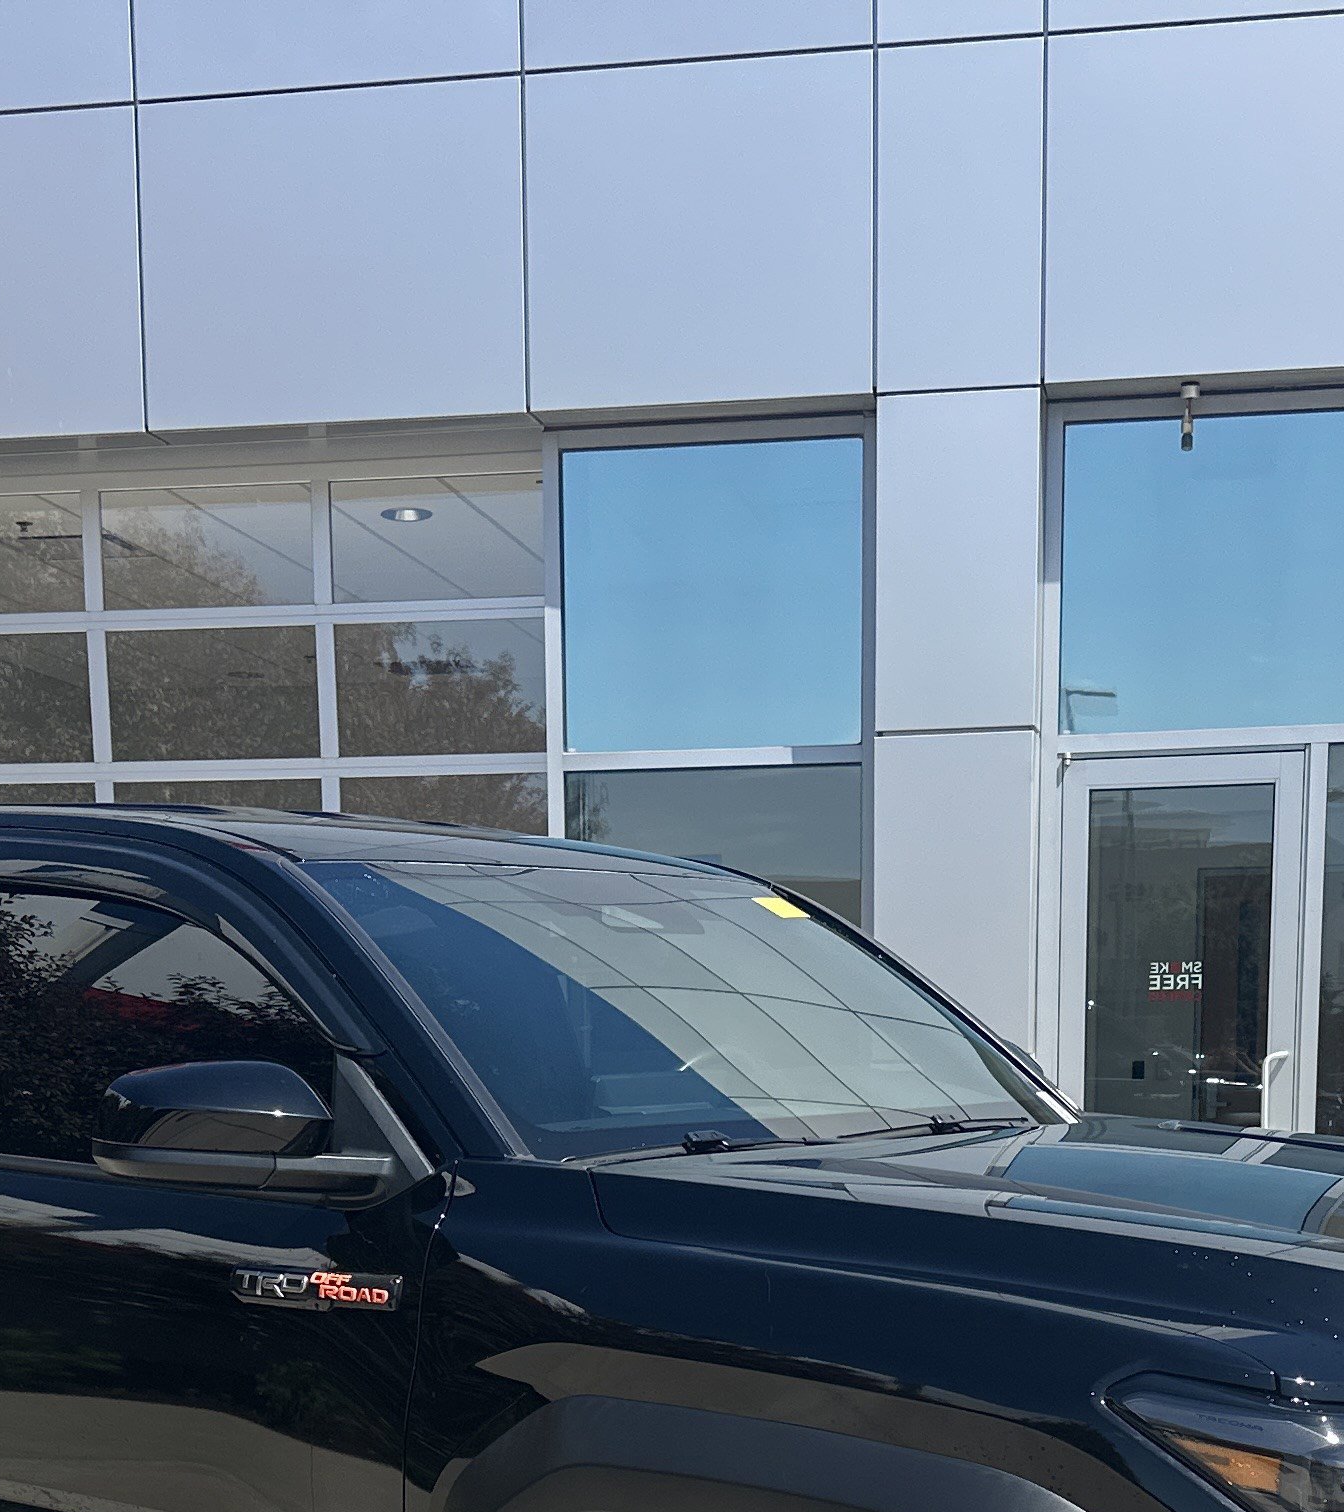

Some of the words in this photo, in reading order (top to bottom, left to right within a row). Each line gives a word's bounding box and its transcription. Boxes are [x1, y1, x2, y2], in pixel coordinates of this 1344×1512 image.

[235, 1269, 309, 1298] TRD
[309, 1271, 353, 1286] OFF
[318, 1284, 390, 1305] ROAD
